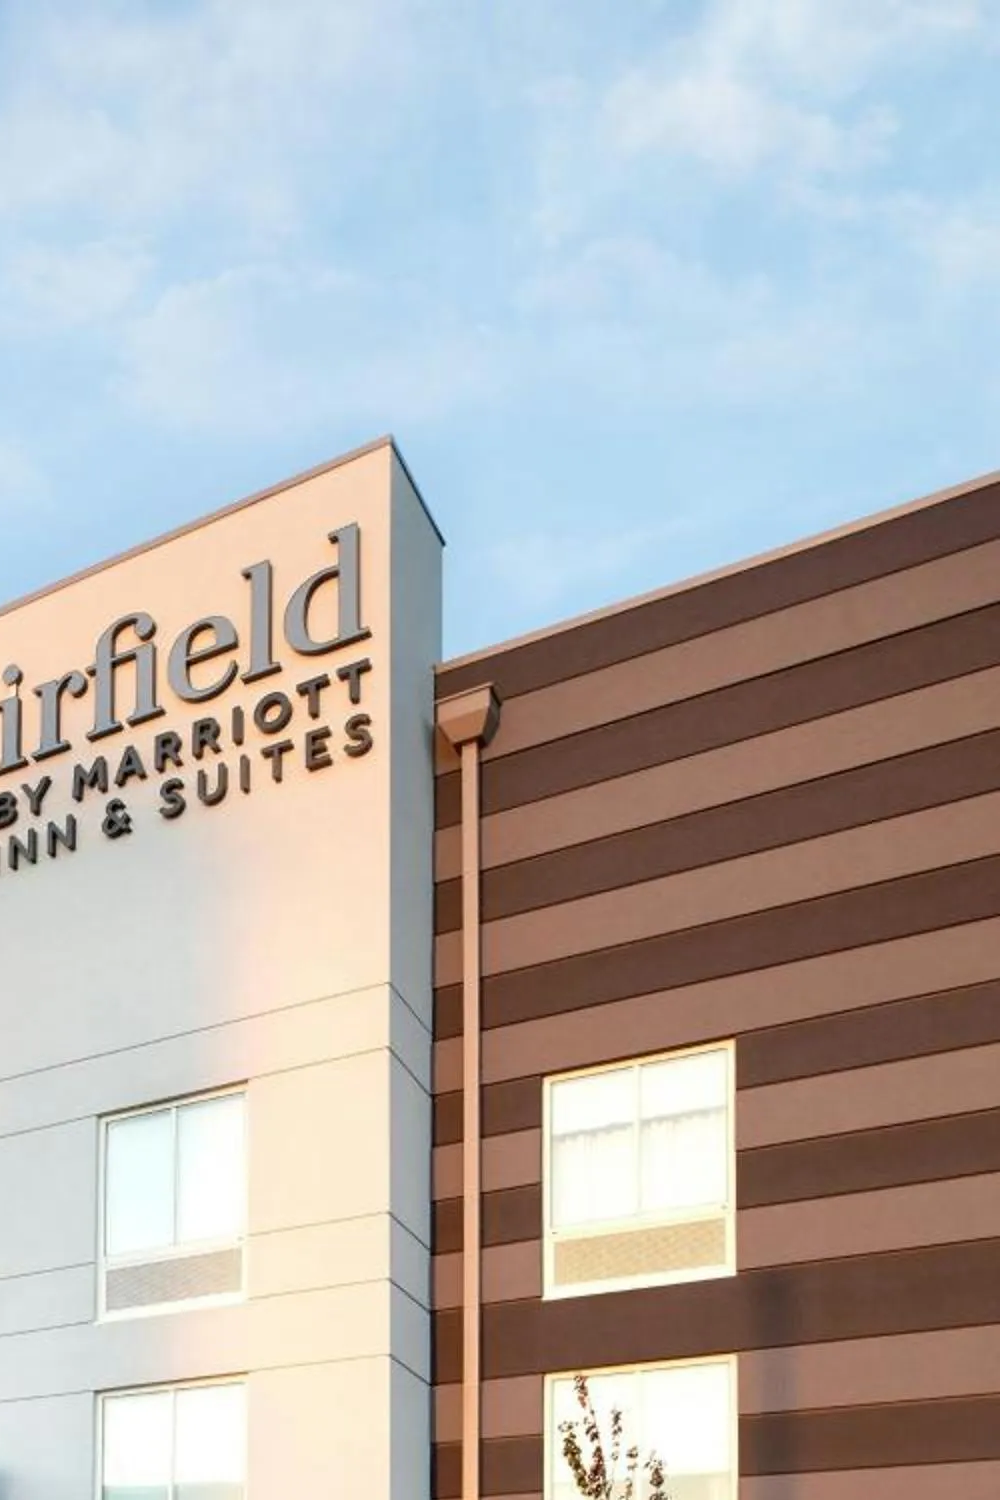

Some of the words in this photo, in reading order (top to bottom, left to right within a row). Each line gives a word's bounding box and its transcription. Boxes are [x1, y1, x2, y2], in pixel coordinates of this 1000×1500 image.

[72, 658, 372, 802] MARRIOTT
[102, 798, 132, 838] &
[159, 713, 374, 819] SUITES
